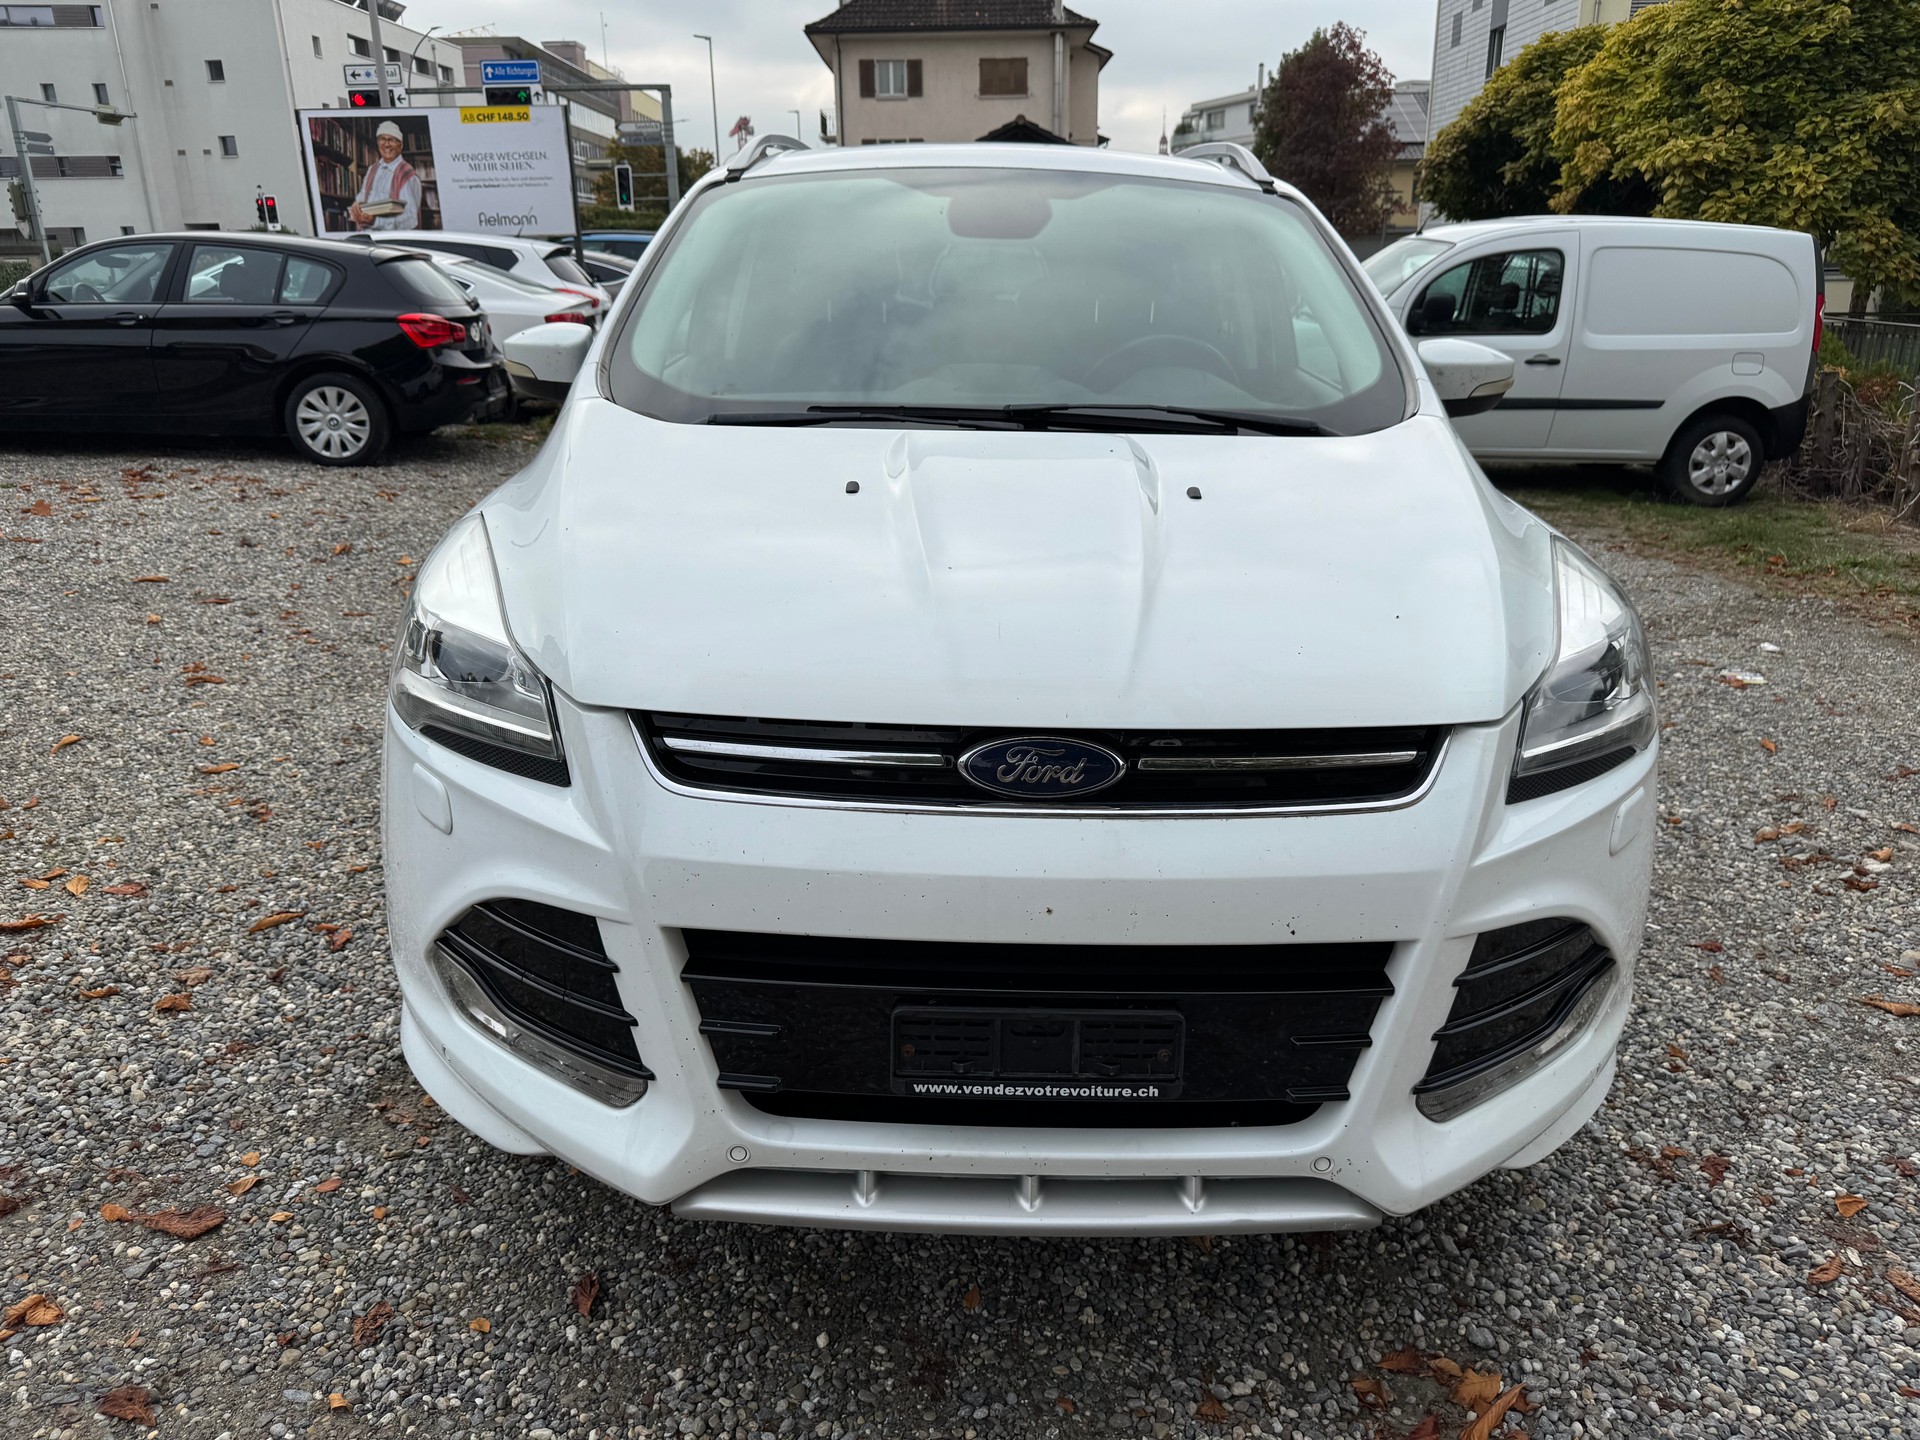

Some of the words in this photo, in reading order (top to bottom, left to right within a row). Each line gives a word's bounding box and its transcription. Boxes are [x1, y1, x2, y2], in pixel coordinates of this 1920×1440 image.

[463, 113, 475, 122] AB
[476, 113, 495, 122] CHF
[498, 112, 529, 121] 148.50
[450, 152, 494, 162] WENIGER
[496, 151, 548, 161] WECHSELN.
[468, 162, 498, 172] MEHR
[499, 161, 535, 171] SEHEN.
[997, 746, 1087, 784] Ford
[913, 1082, 1159, 1097] www.vendezvotrevoiture.ch
